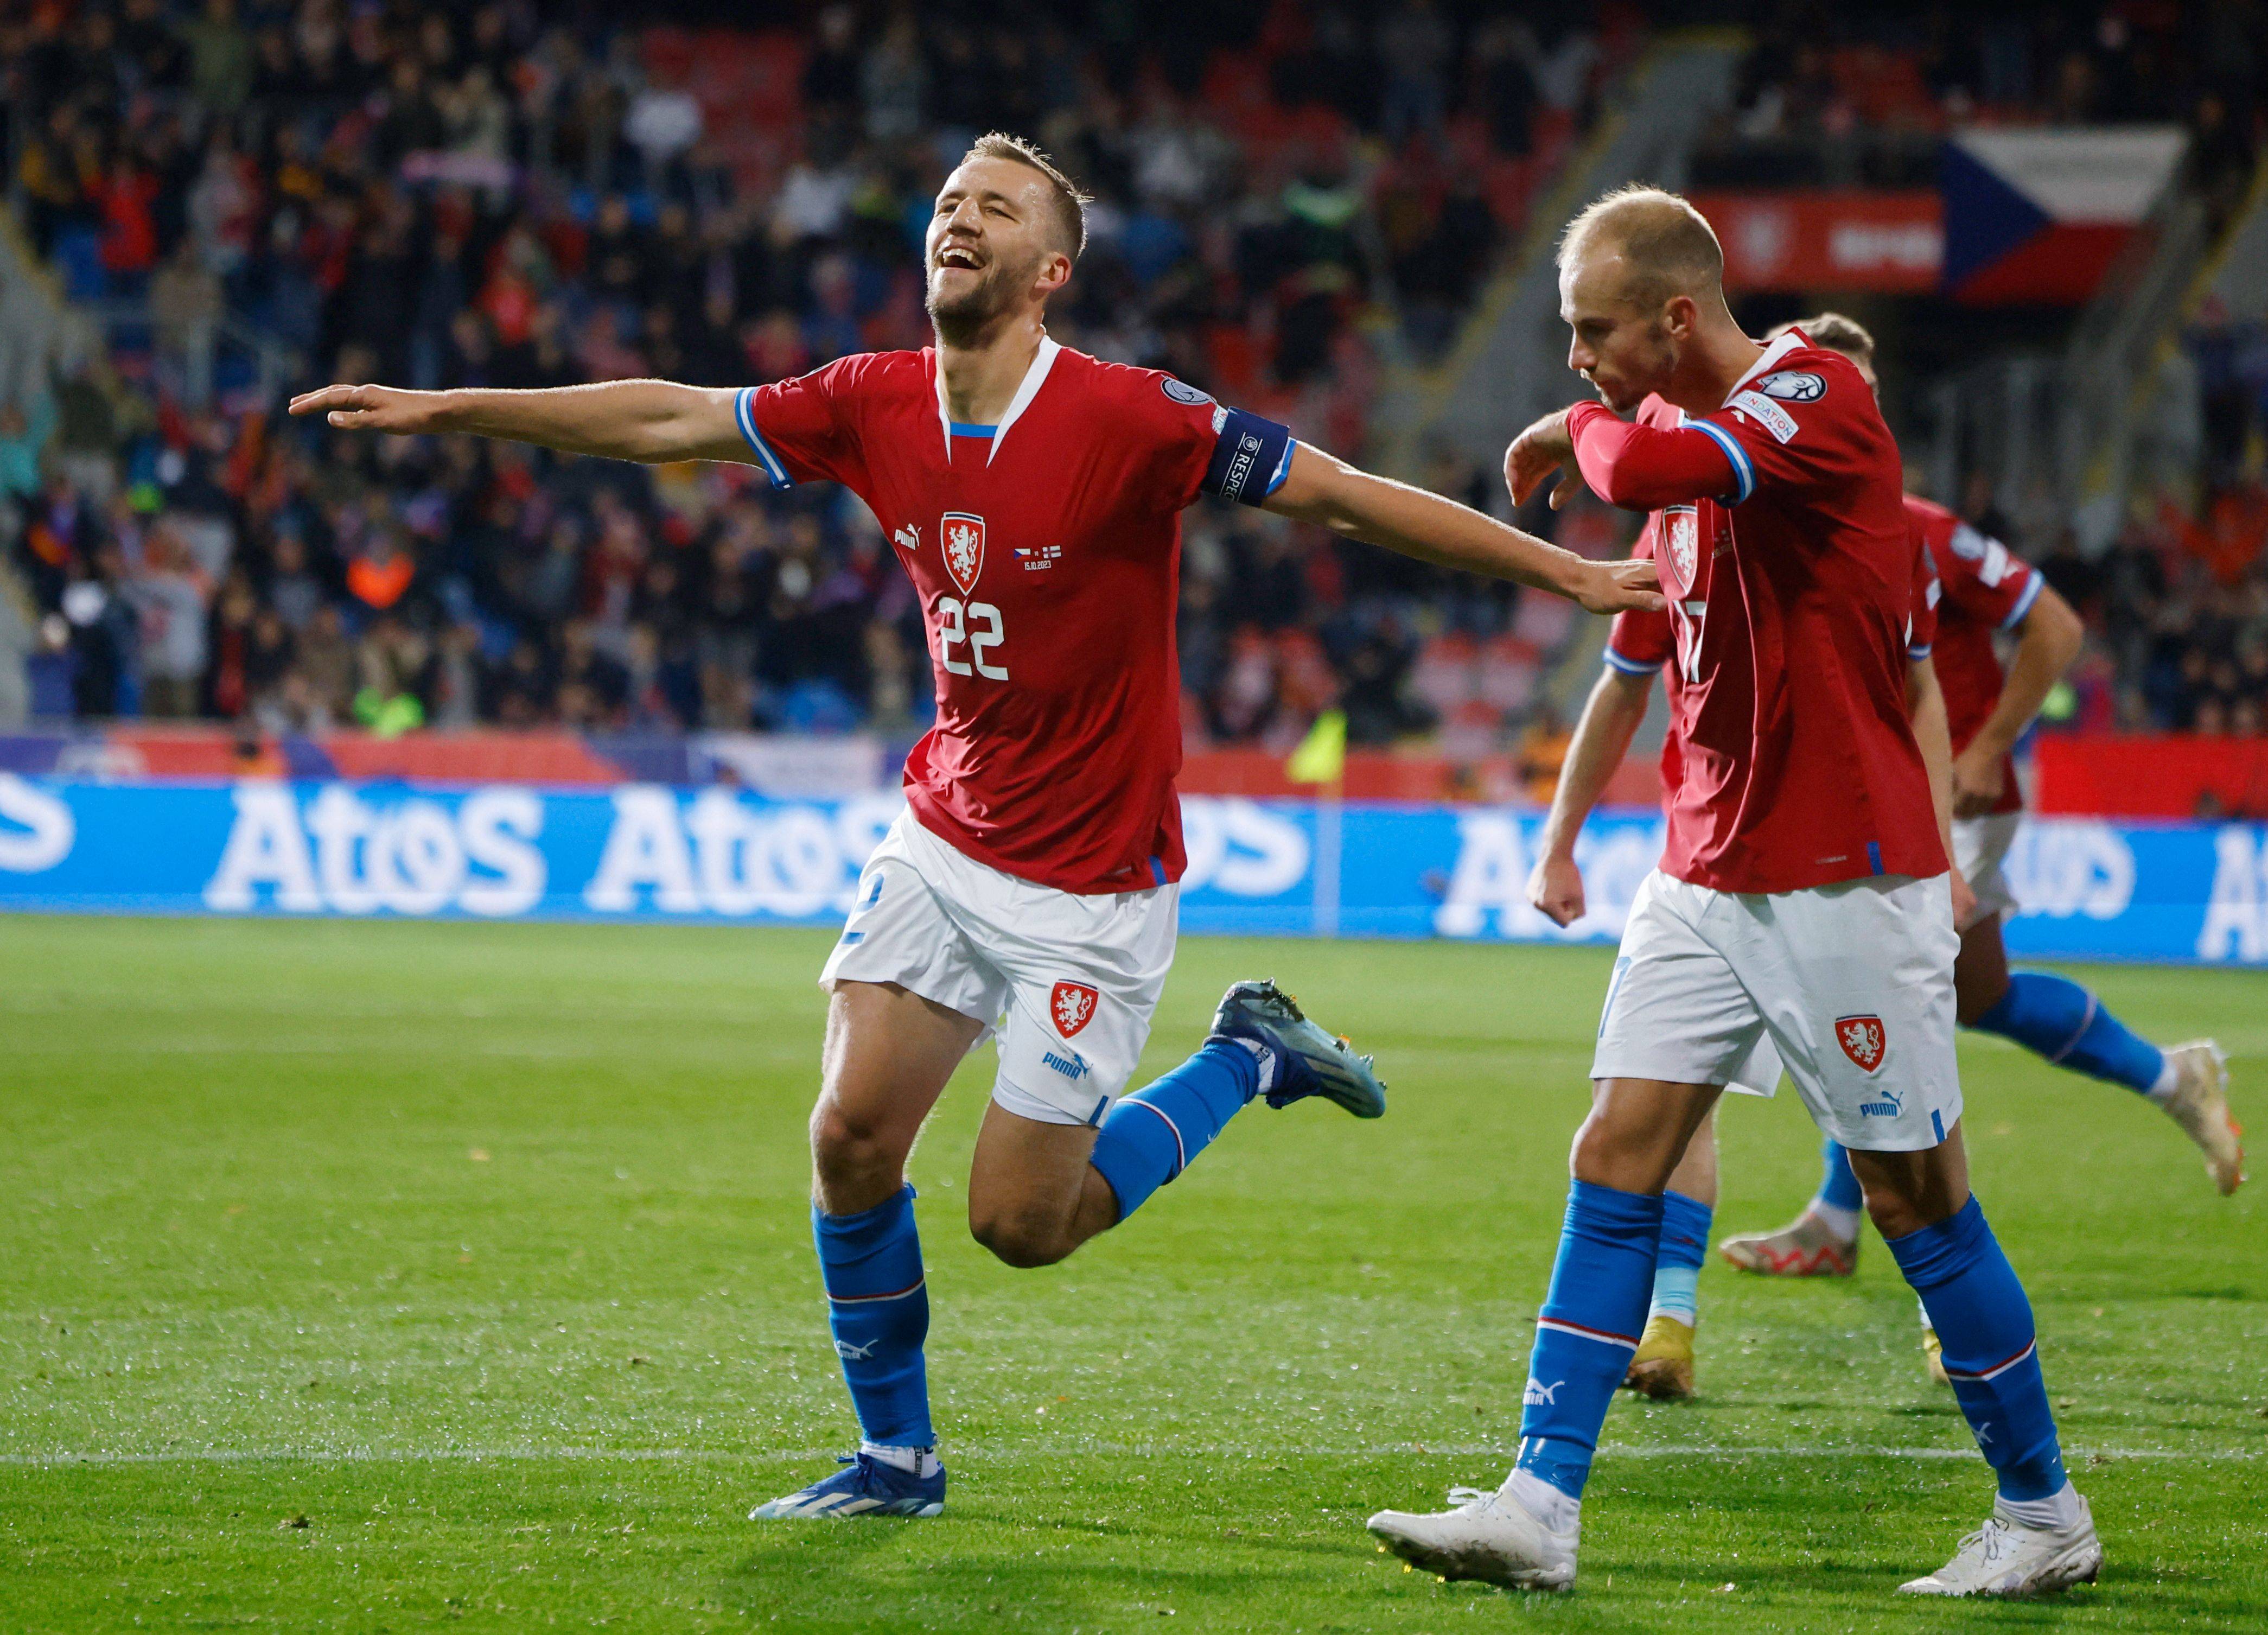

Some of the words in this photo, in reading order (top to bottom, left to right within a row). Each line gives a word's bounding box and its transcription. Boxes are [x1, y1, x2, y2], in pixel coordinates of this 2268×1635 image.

[1224, 453, 1250, 501] RESPEC
[895, 529, 916, 550] PUMA
[1024, 560, 1052, 571] 15.10.2023
[939, 597, 1009, 680] 22
[1042, 1051, 1082, 1080] PUMA
[1860, 1103, 1897, 1117] PUMA
